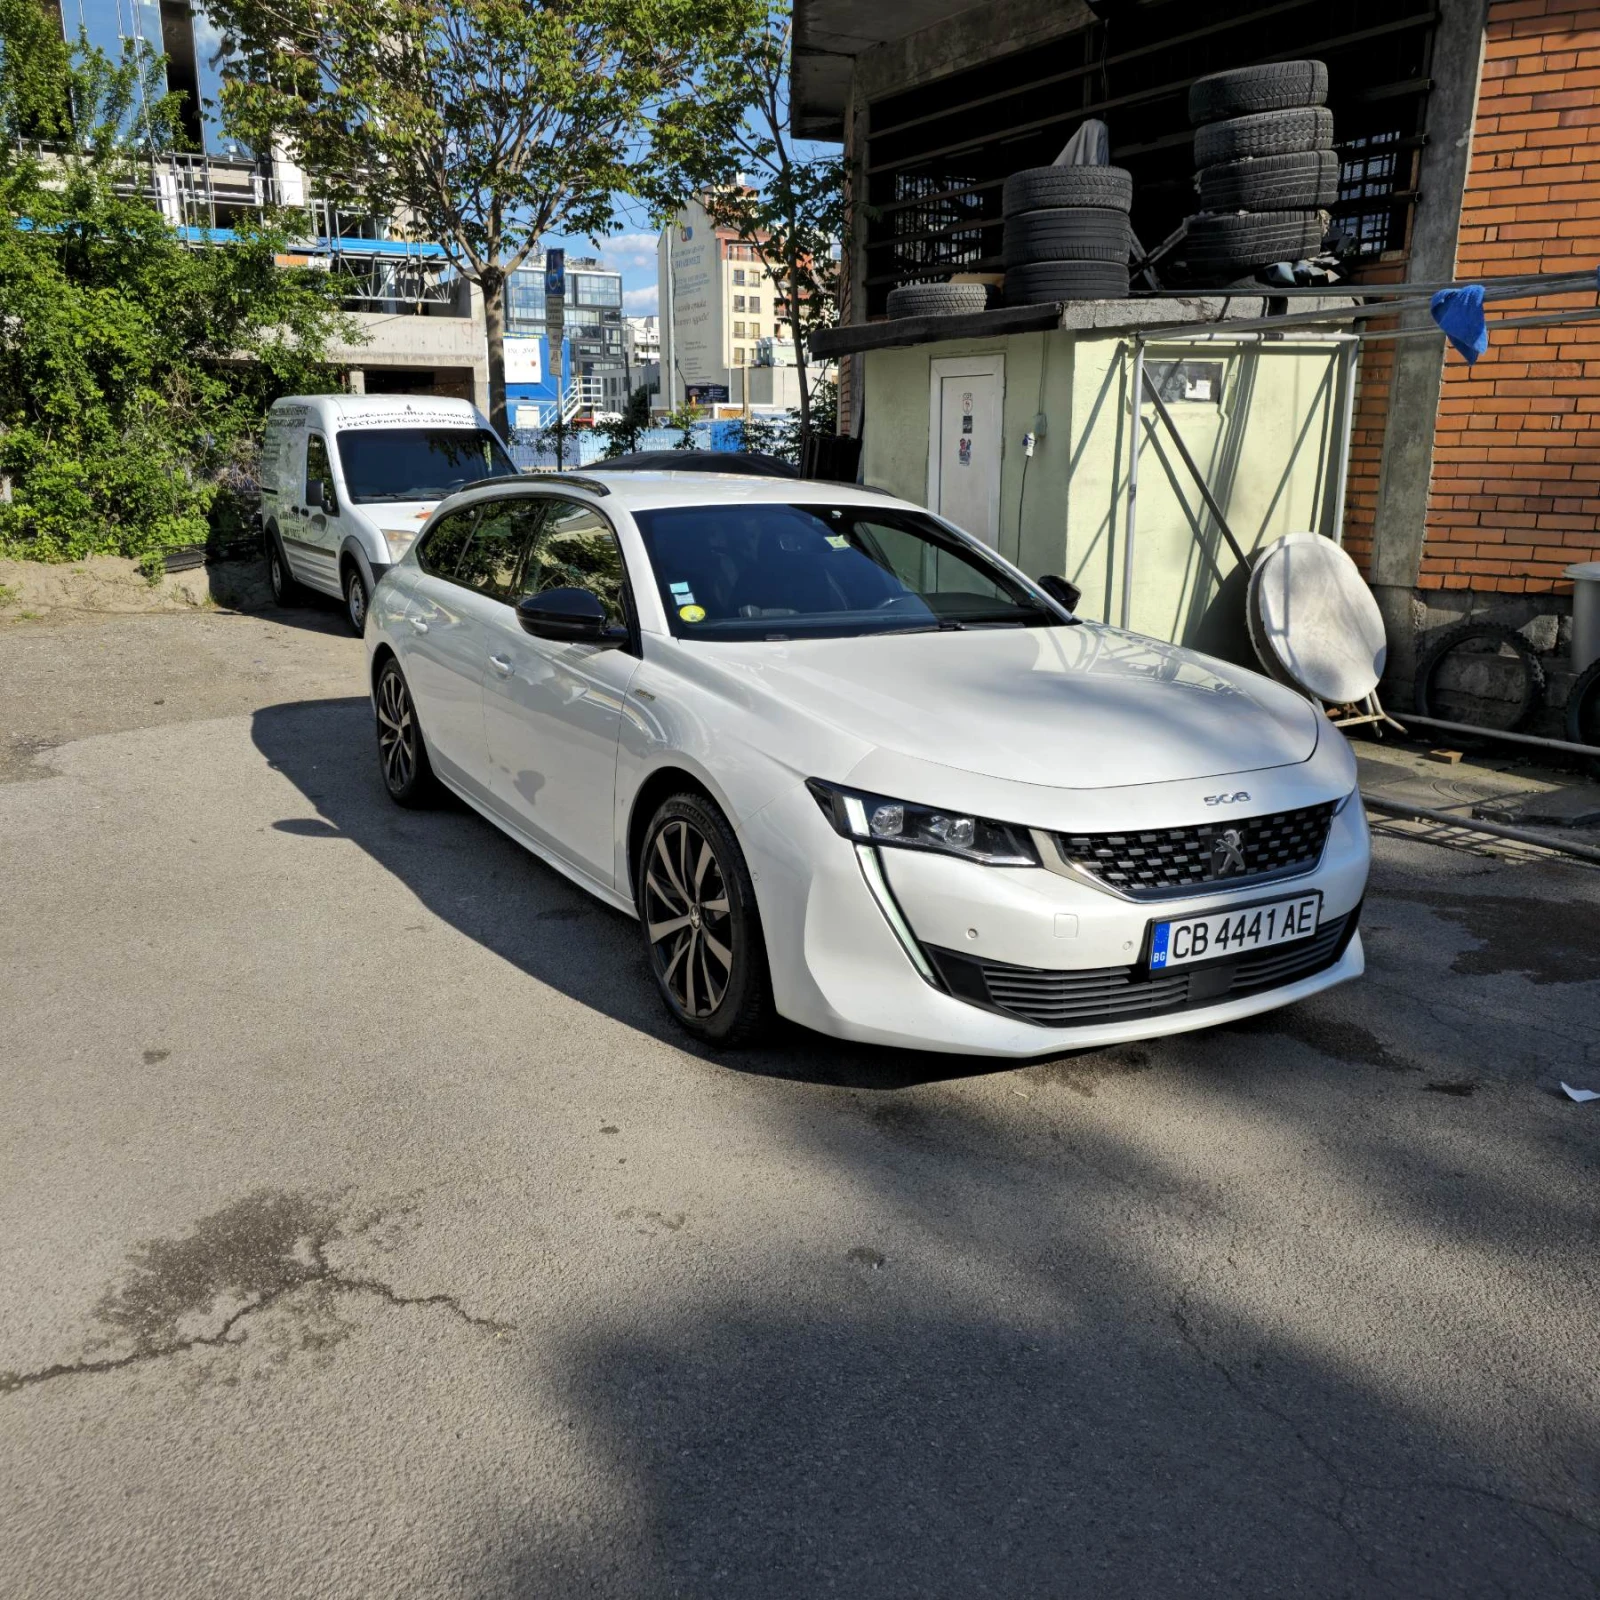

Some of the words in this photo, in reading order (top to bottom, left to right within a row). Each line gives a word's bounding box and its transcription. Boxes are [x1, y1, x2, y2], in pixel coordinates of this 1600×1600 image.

[1203, 791, 1252, 806] 508
[1173, 923, 1209, 959] CB
[1214, 908, 1277, 951] 4441
[1281, 900, 1315, 939] AE
[1153, 952, 1166, 963] BG
